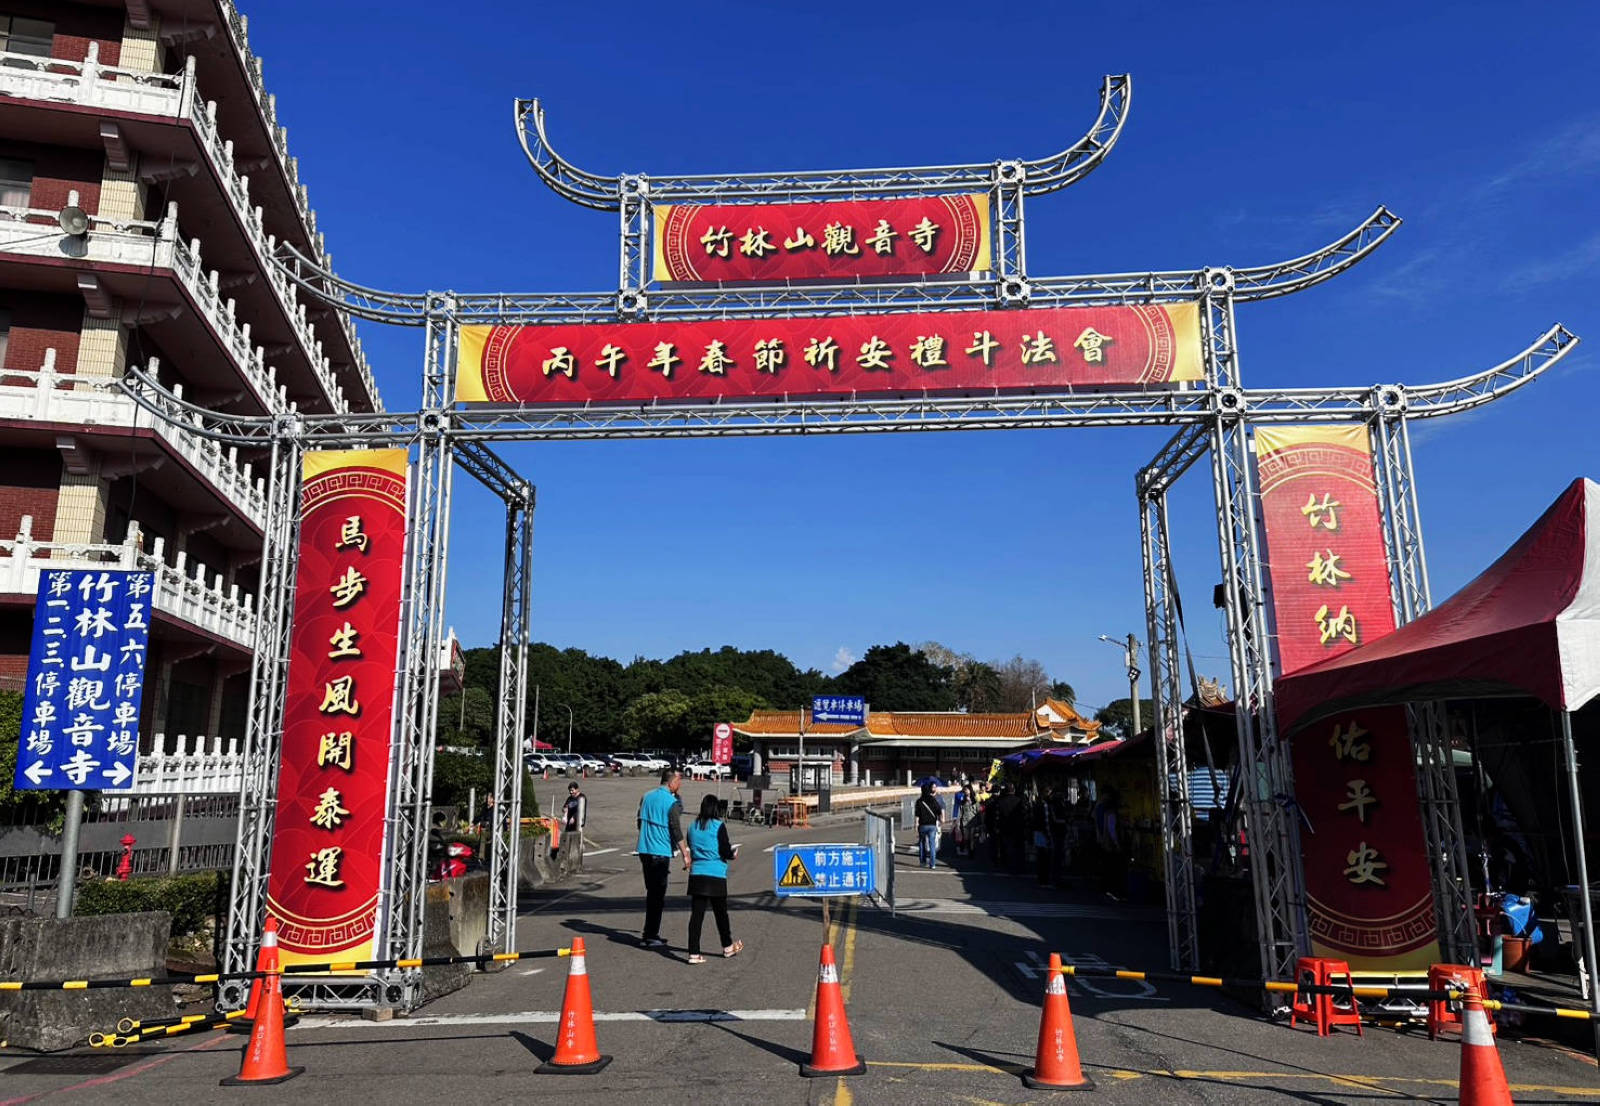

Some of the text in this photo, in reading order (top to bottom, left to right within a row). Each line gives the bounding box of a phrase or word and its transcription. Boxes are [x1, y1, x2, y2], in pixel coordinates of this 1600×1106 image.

[700, 215, 939, 258] 竹林山觀音寺
[541, 326, 1113, 378] 丙午年春節祈安禮斗法會
[60, 573, 120, 785] 竹林山觀音寺
[304, 515, 369, 888] 馬步生風開泰運
[1301, 491, 1388, 886] 竹林納佑平安
[814, 871, 868, 887] 禁止通行
